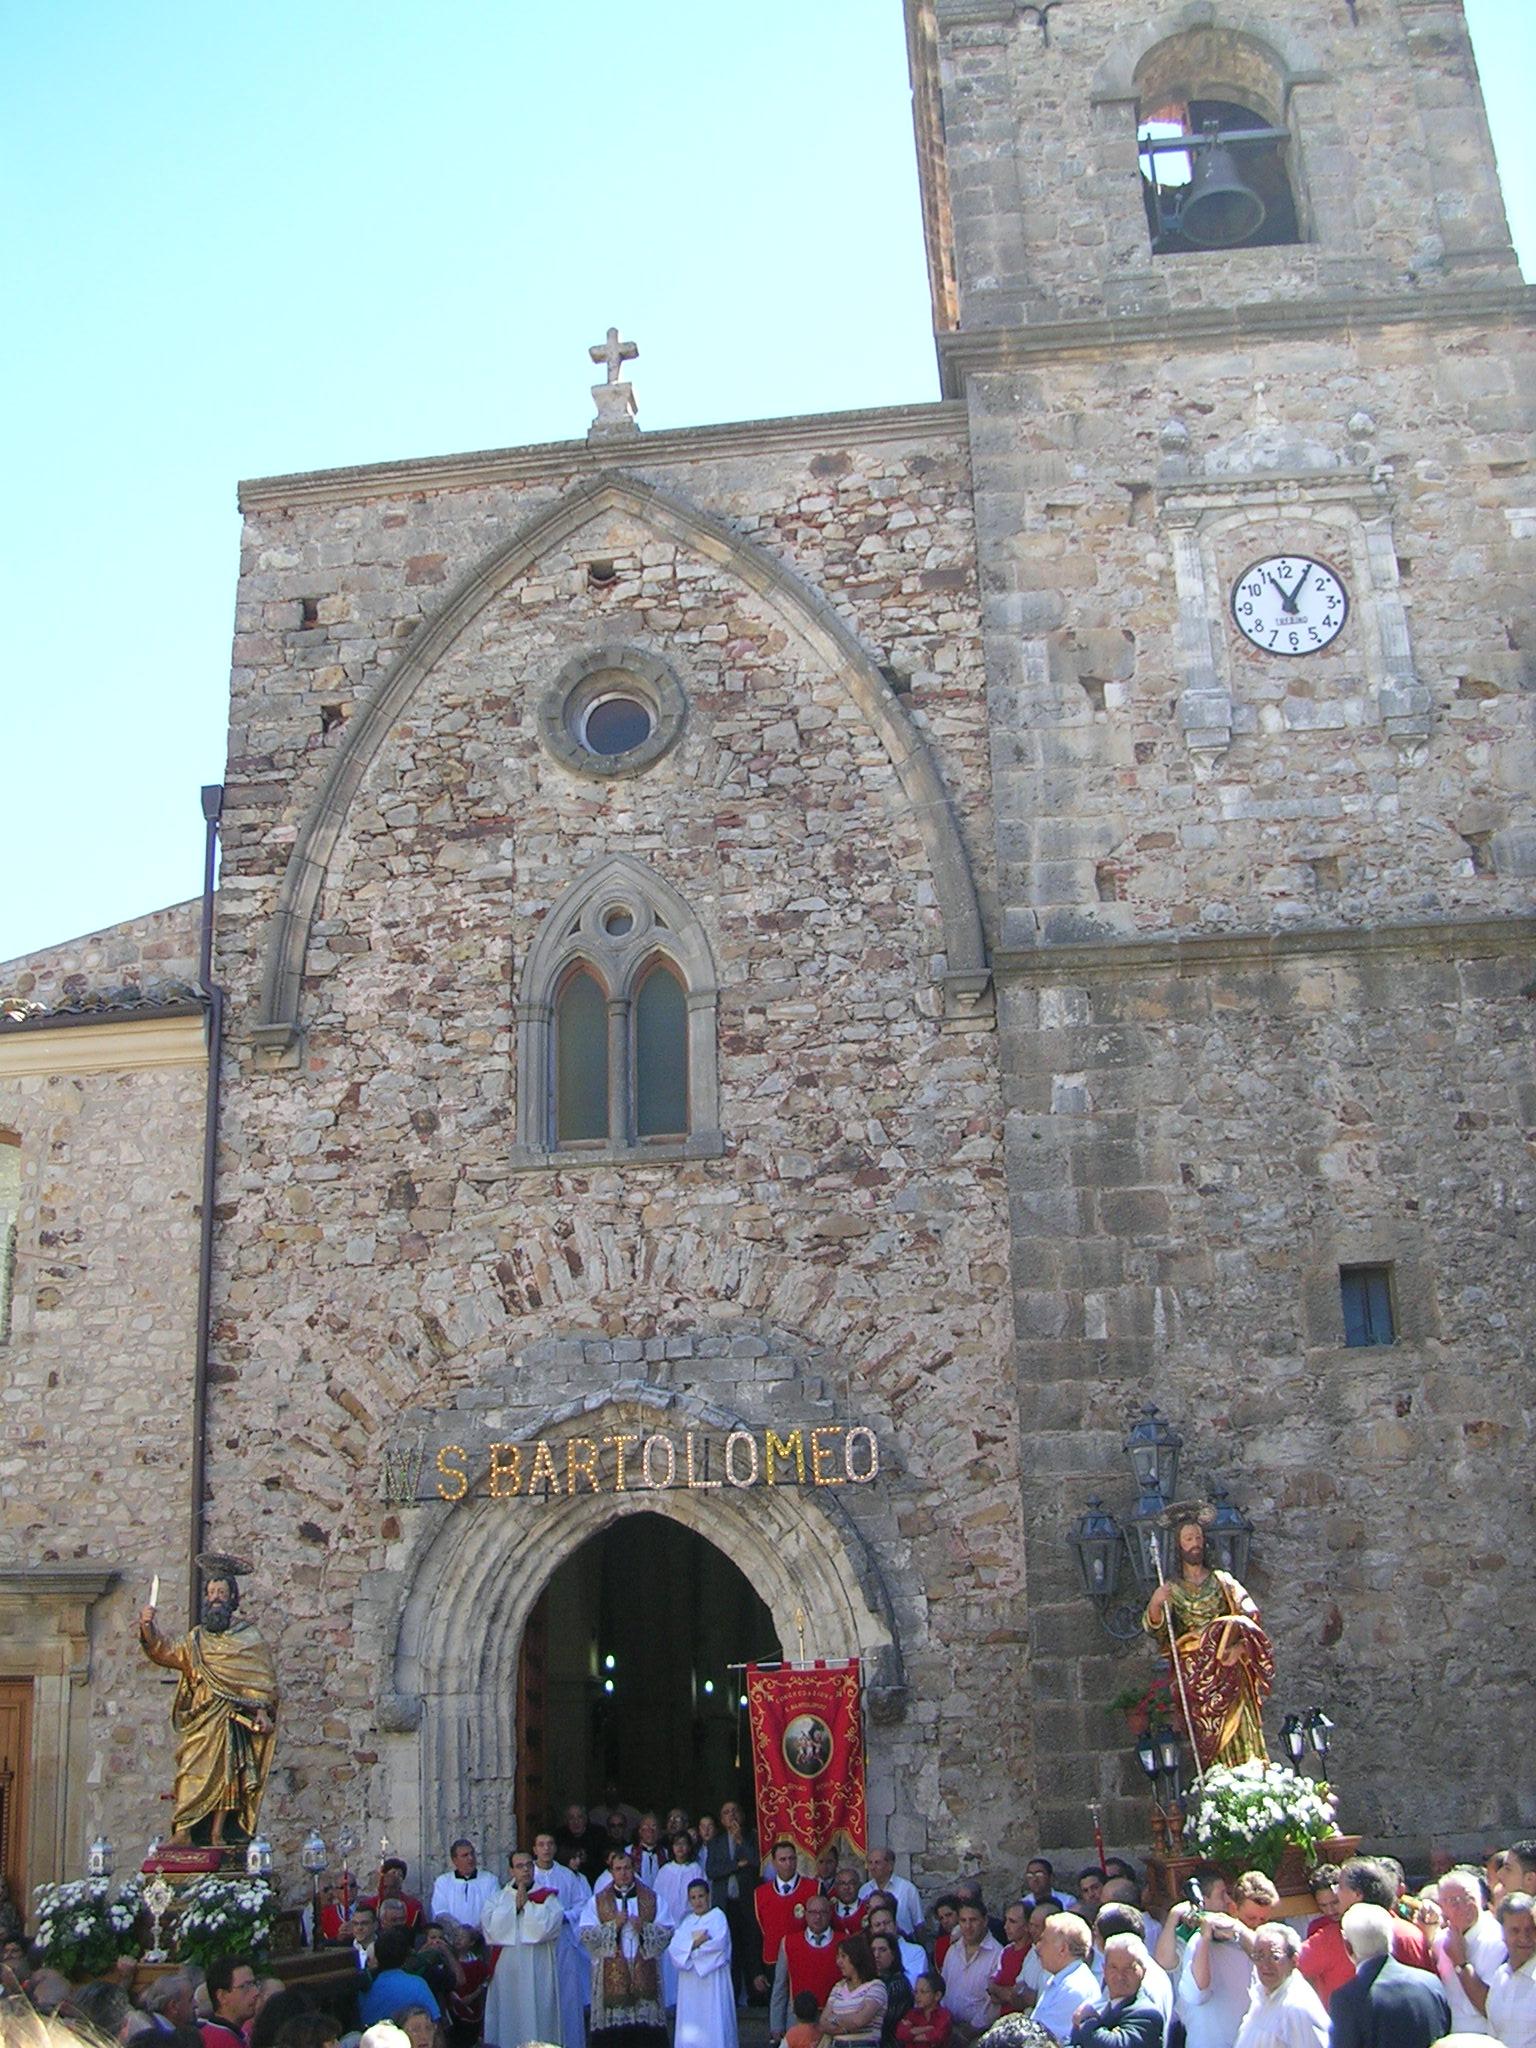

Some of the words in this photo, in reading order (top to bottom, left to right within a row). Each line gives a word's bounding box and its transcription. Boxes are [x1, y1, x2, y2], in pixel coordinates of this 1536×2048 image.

[1261, 571, 1274, 585] 11
[1277, 565, 1293, 579] 12
[1247, 583, 1262, 597] 10
[1315, 578, 1326, 592] 2
[1243, 601, 1253, 616] 9
[1326, 595, 1336, 609] 3
[1254, 618, 1264, 633] 8
[1322, 614, 1332, 627] 4
[1270, 629, 1279, 644] 7
[1288, 631, 1299, 645] 6
[1308, 626, 1318, 640] 5
[436, 1445, 468, 1501] S
[489, 1426, 879, 1498] BARTOLOMEO
